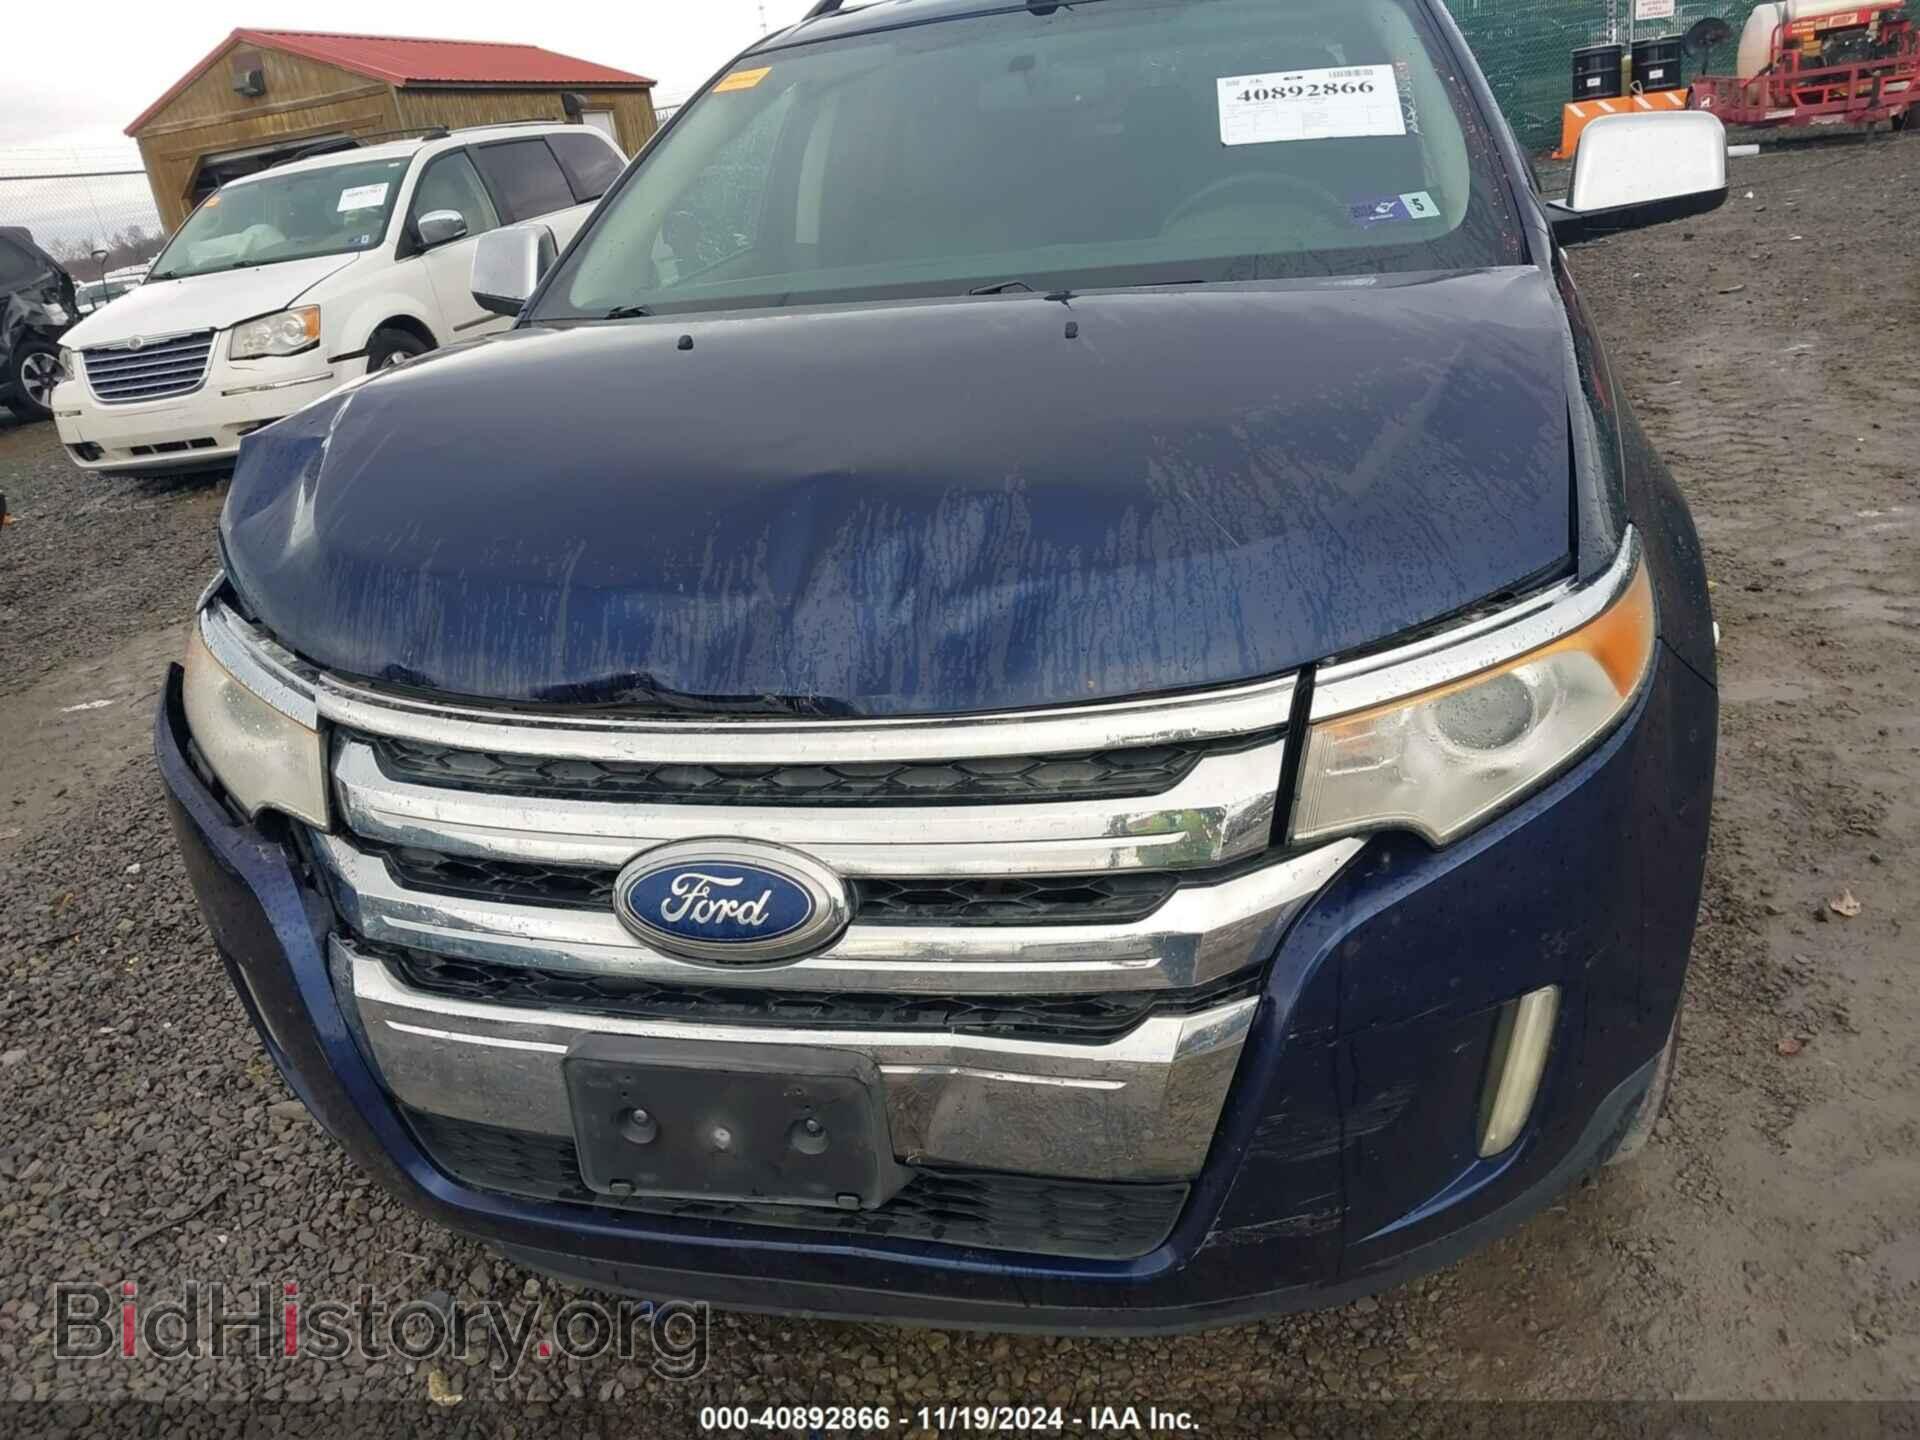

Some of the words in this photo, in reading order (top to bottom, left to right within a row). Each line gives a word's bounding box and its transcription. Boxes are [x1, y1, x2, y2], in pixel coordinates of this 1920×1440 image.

[1236, 80, 1374, 102] 40892866
[1411, 198, 1425, 211] 5
[660, 872, 772, 927] Ford
